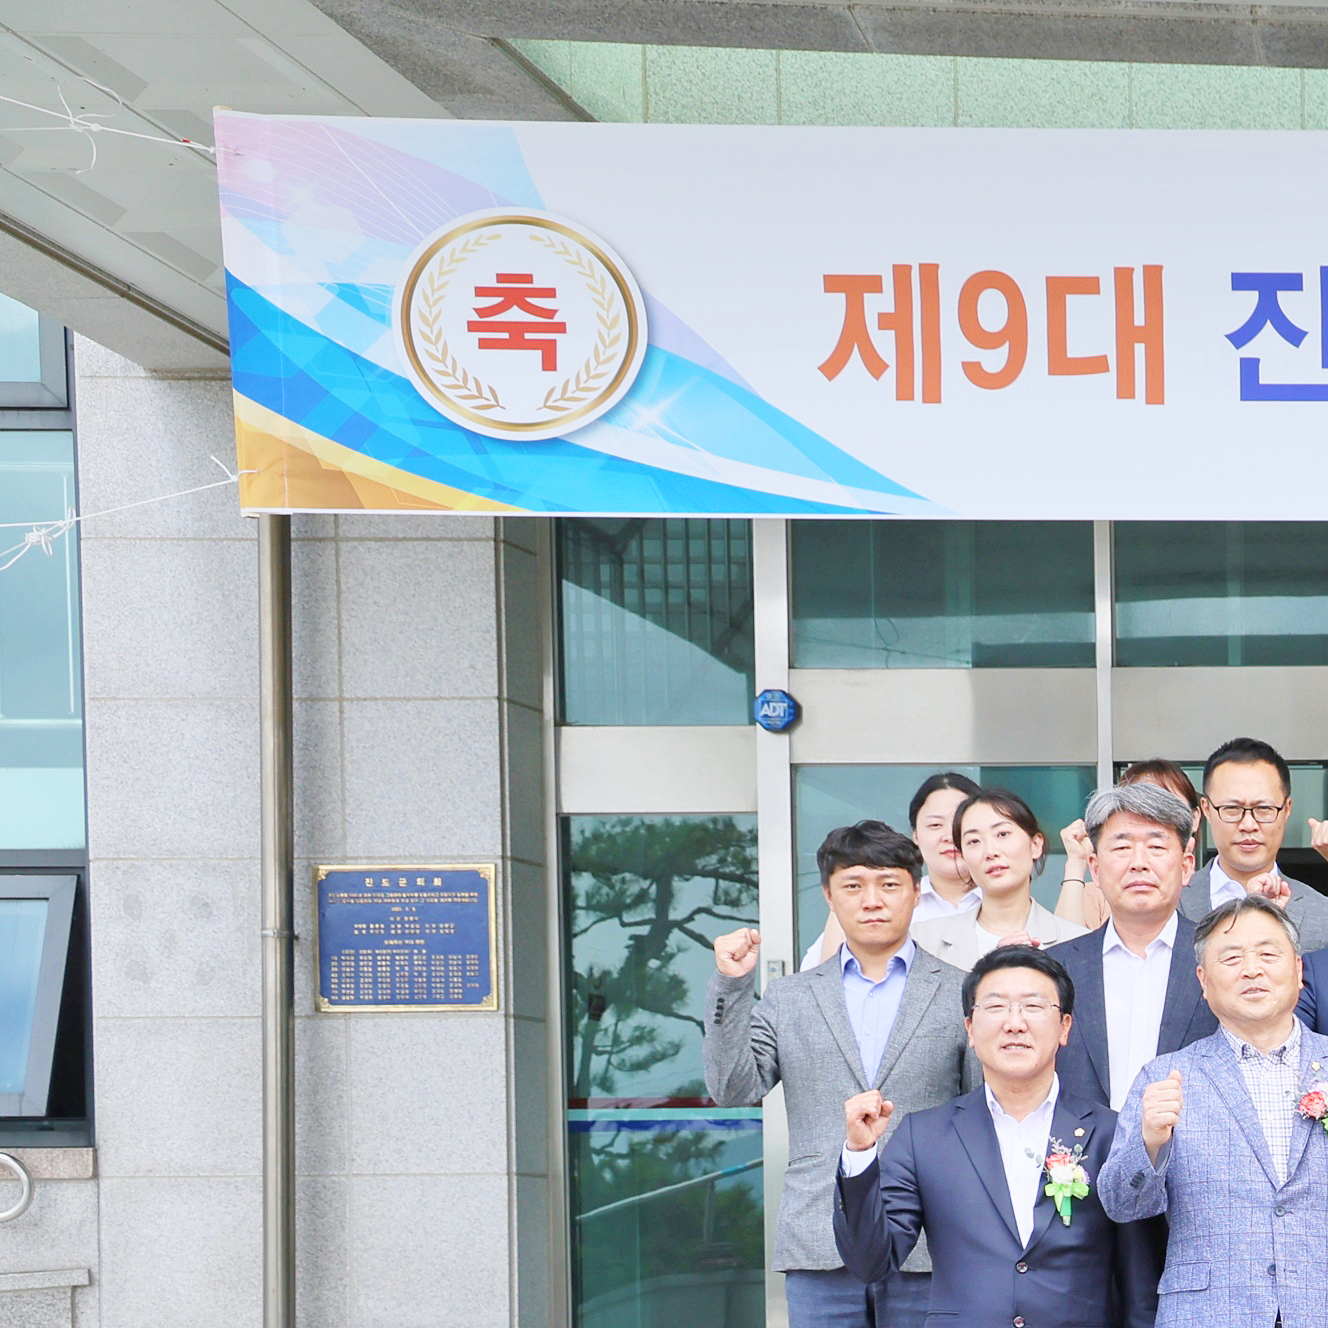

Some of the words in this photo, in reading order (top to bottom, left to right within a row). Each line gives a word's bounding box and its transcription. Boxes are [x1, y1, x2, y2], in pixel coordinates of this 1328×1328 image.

[467, 273, 567, 372] 축
[818, 263, 1164, 404] 제9대
[759, 702, 788, 717] ADT
